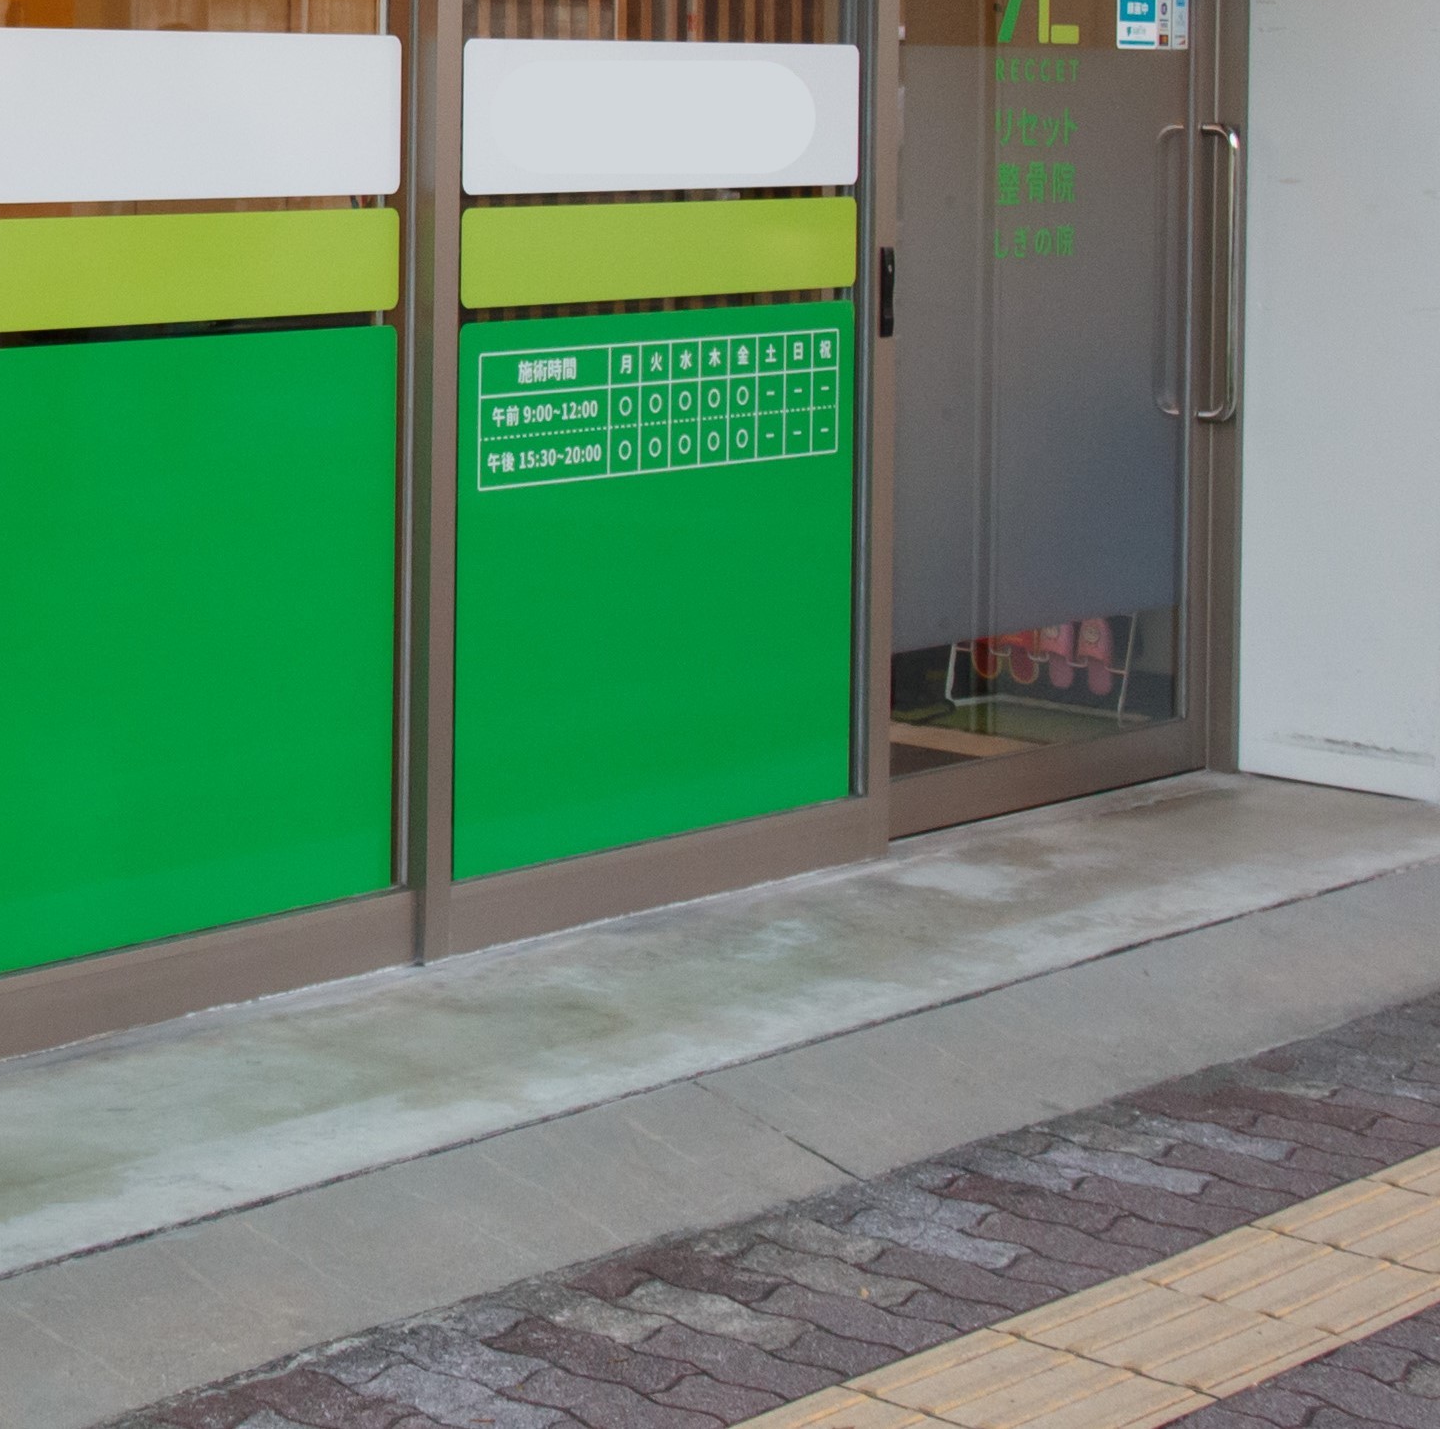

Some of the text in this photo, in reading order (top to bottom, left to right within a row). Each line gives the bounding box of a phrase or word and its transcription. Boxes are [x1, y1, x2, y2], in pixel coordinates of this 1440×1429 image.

[995, 57, 1080, 83] RECCET
[995, 107, 1079, 147] リセット
[996, 161, 1077, 206] 整骨院
[994, 225, 1075, 259] しぎの院
[517, 339, 832, 385] 施術時間 月 火 水 木 金 土 日 祝
[492, 405, 519, 428] 午前
[487, 451, 516, 474] 午後
